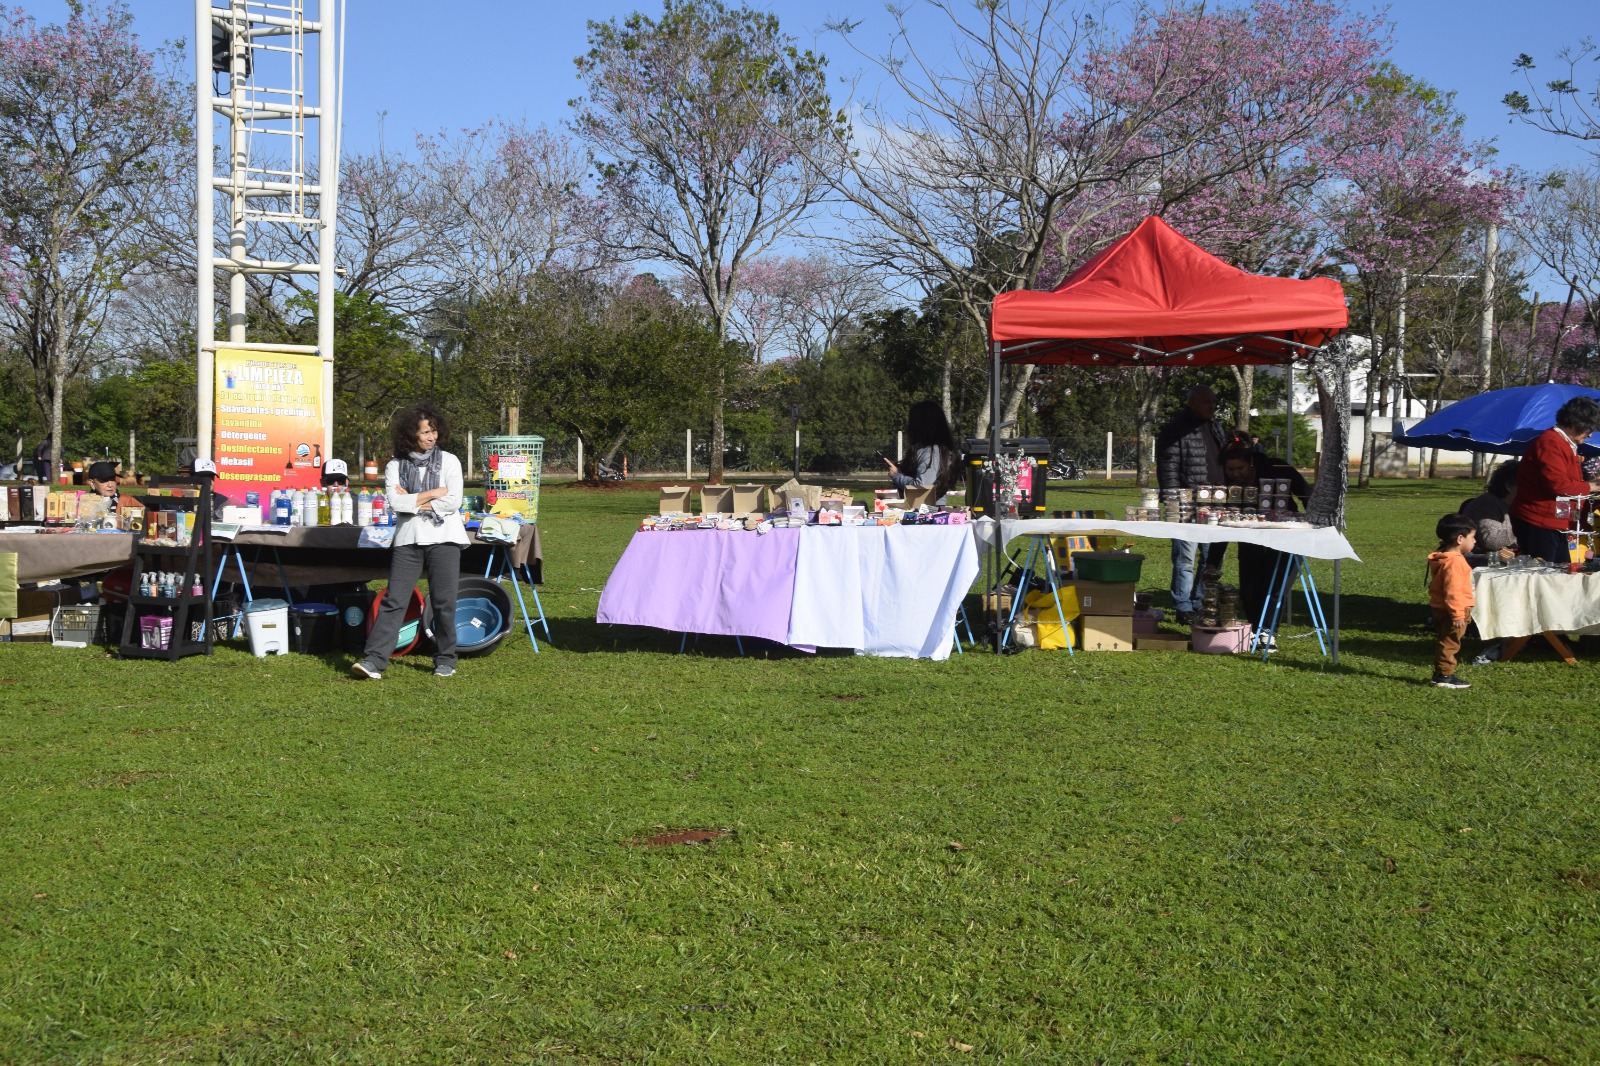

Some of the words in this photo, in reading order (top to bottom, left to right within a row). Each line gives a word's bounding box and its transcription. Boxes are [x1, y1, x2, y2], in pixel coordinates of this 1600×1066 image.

[237, 365, 304, 385] LIMPIEZA
[220, 404, 269, 415] Suavizantes
[221, 418, 262, 428] Lavandina
[221, 431, 267, 441] Detergente
[221, 444, 282, 454] Desinfectantes
[221, 457, 254, 466] Mekasil
[219, 472, 281, 482] Desengrasante
